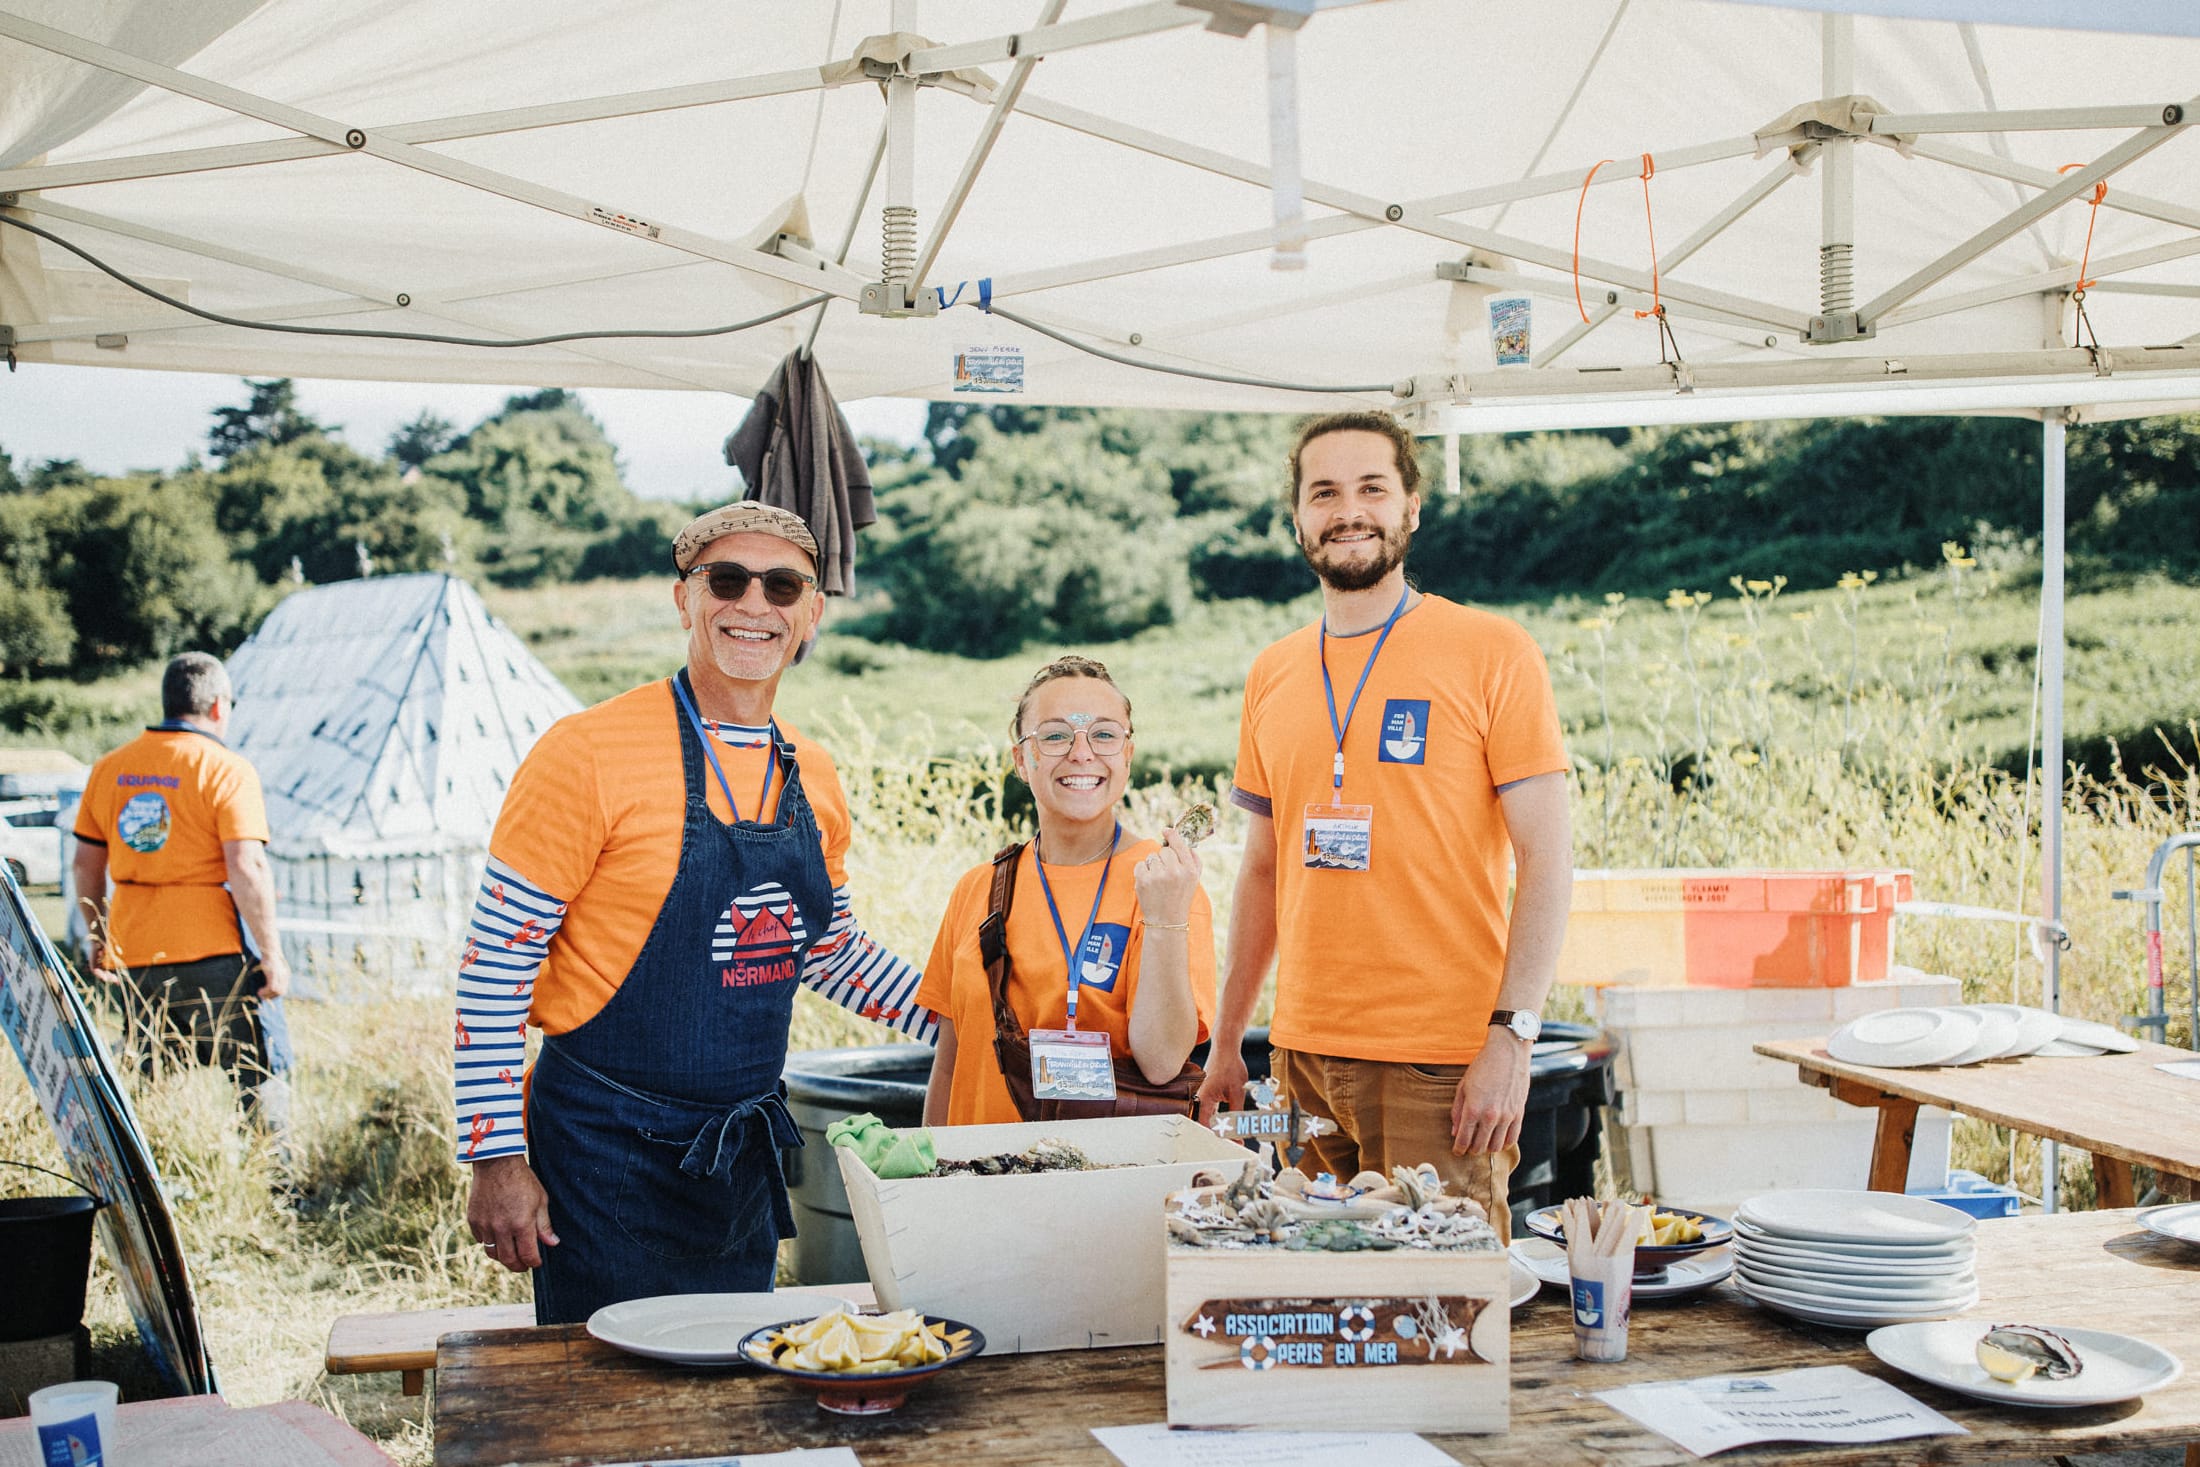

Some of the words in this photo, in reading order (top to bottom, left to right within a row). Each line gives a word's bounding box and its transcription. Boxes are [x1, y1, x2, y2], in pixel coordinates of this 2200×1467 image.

[758, 921, 779, 938] chef
[722, 959, 795, 987] NORMAND
[1236, 1114, 1289, 1135] MERCI
[1225, 1313, 1334, 1336] ASSOCIATION
[1276, 1343, 1323, 1364] PERIS
[1336, 1343, 1356, 1364] EN
[1364, 1342, 1398, 1364] MER
[1820, 1412, 1914, 1429] Chardonnay
